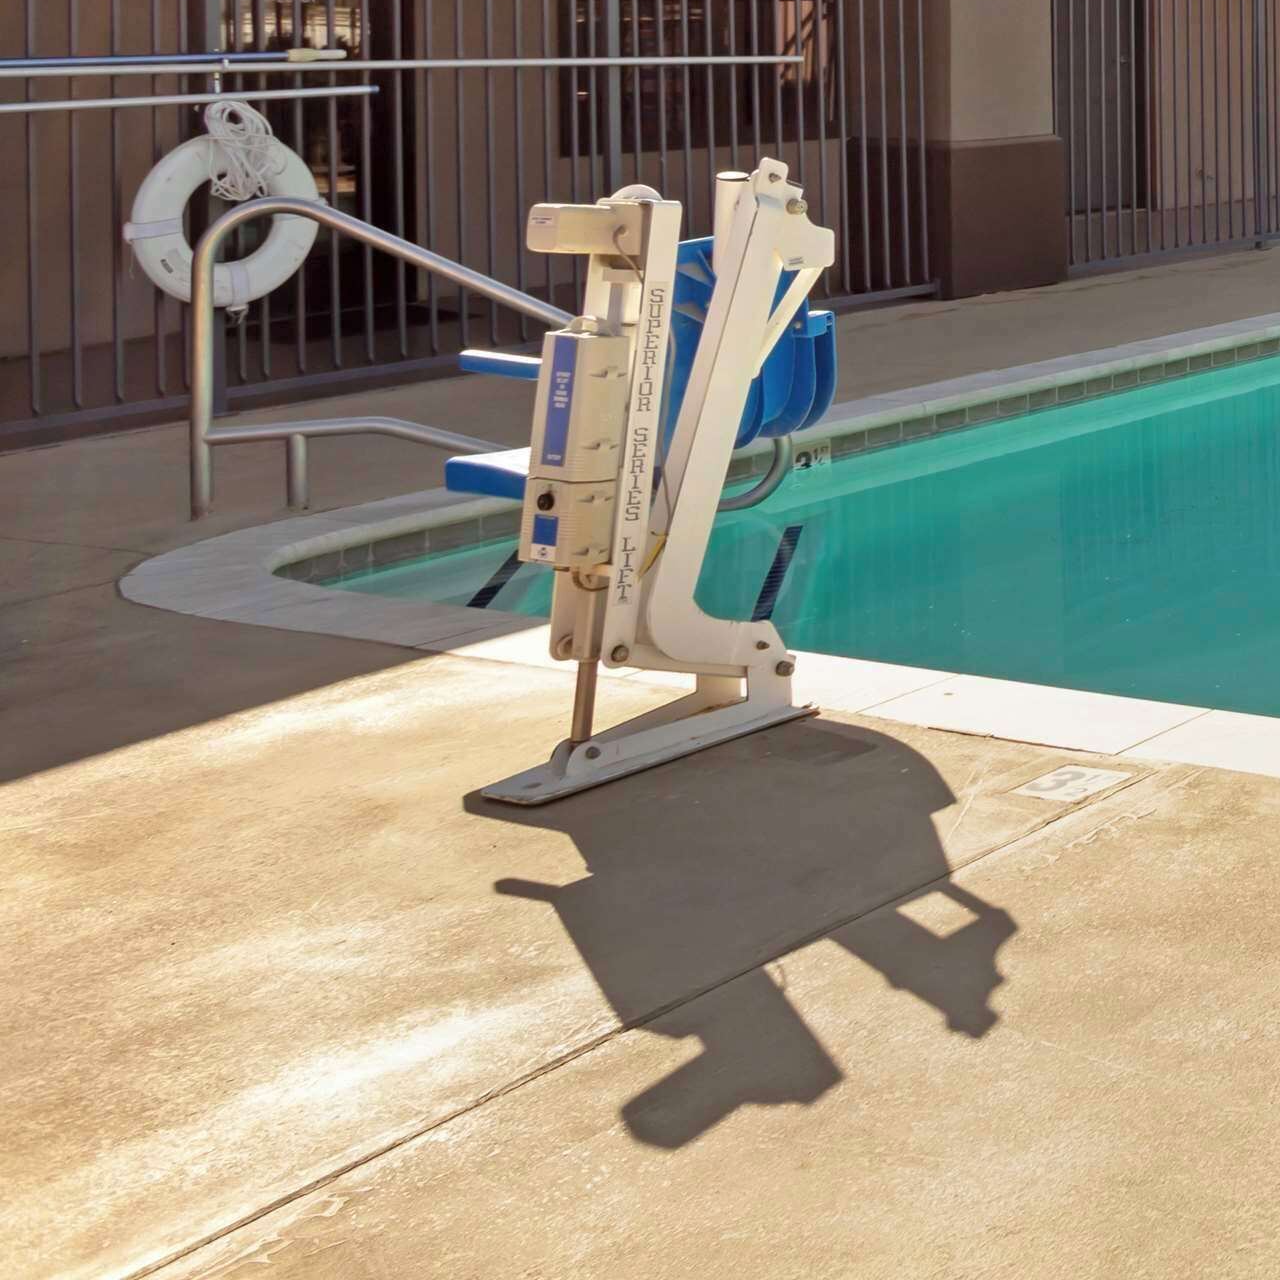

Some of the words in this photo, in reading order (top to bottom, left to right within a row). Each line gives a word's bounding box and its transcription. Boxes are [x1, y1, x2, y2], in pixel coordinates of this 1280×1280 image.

[636, 288, 665, 412] SUPERIOR
[625, 427, 649, 521] SERIES
[616, 536, 637, 601] LIFT
